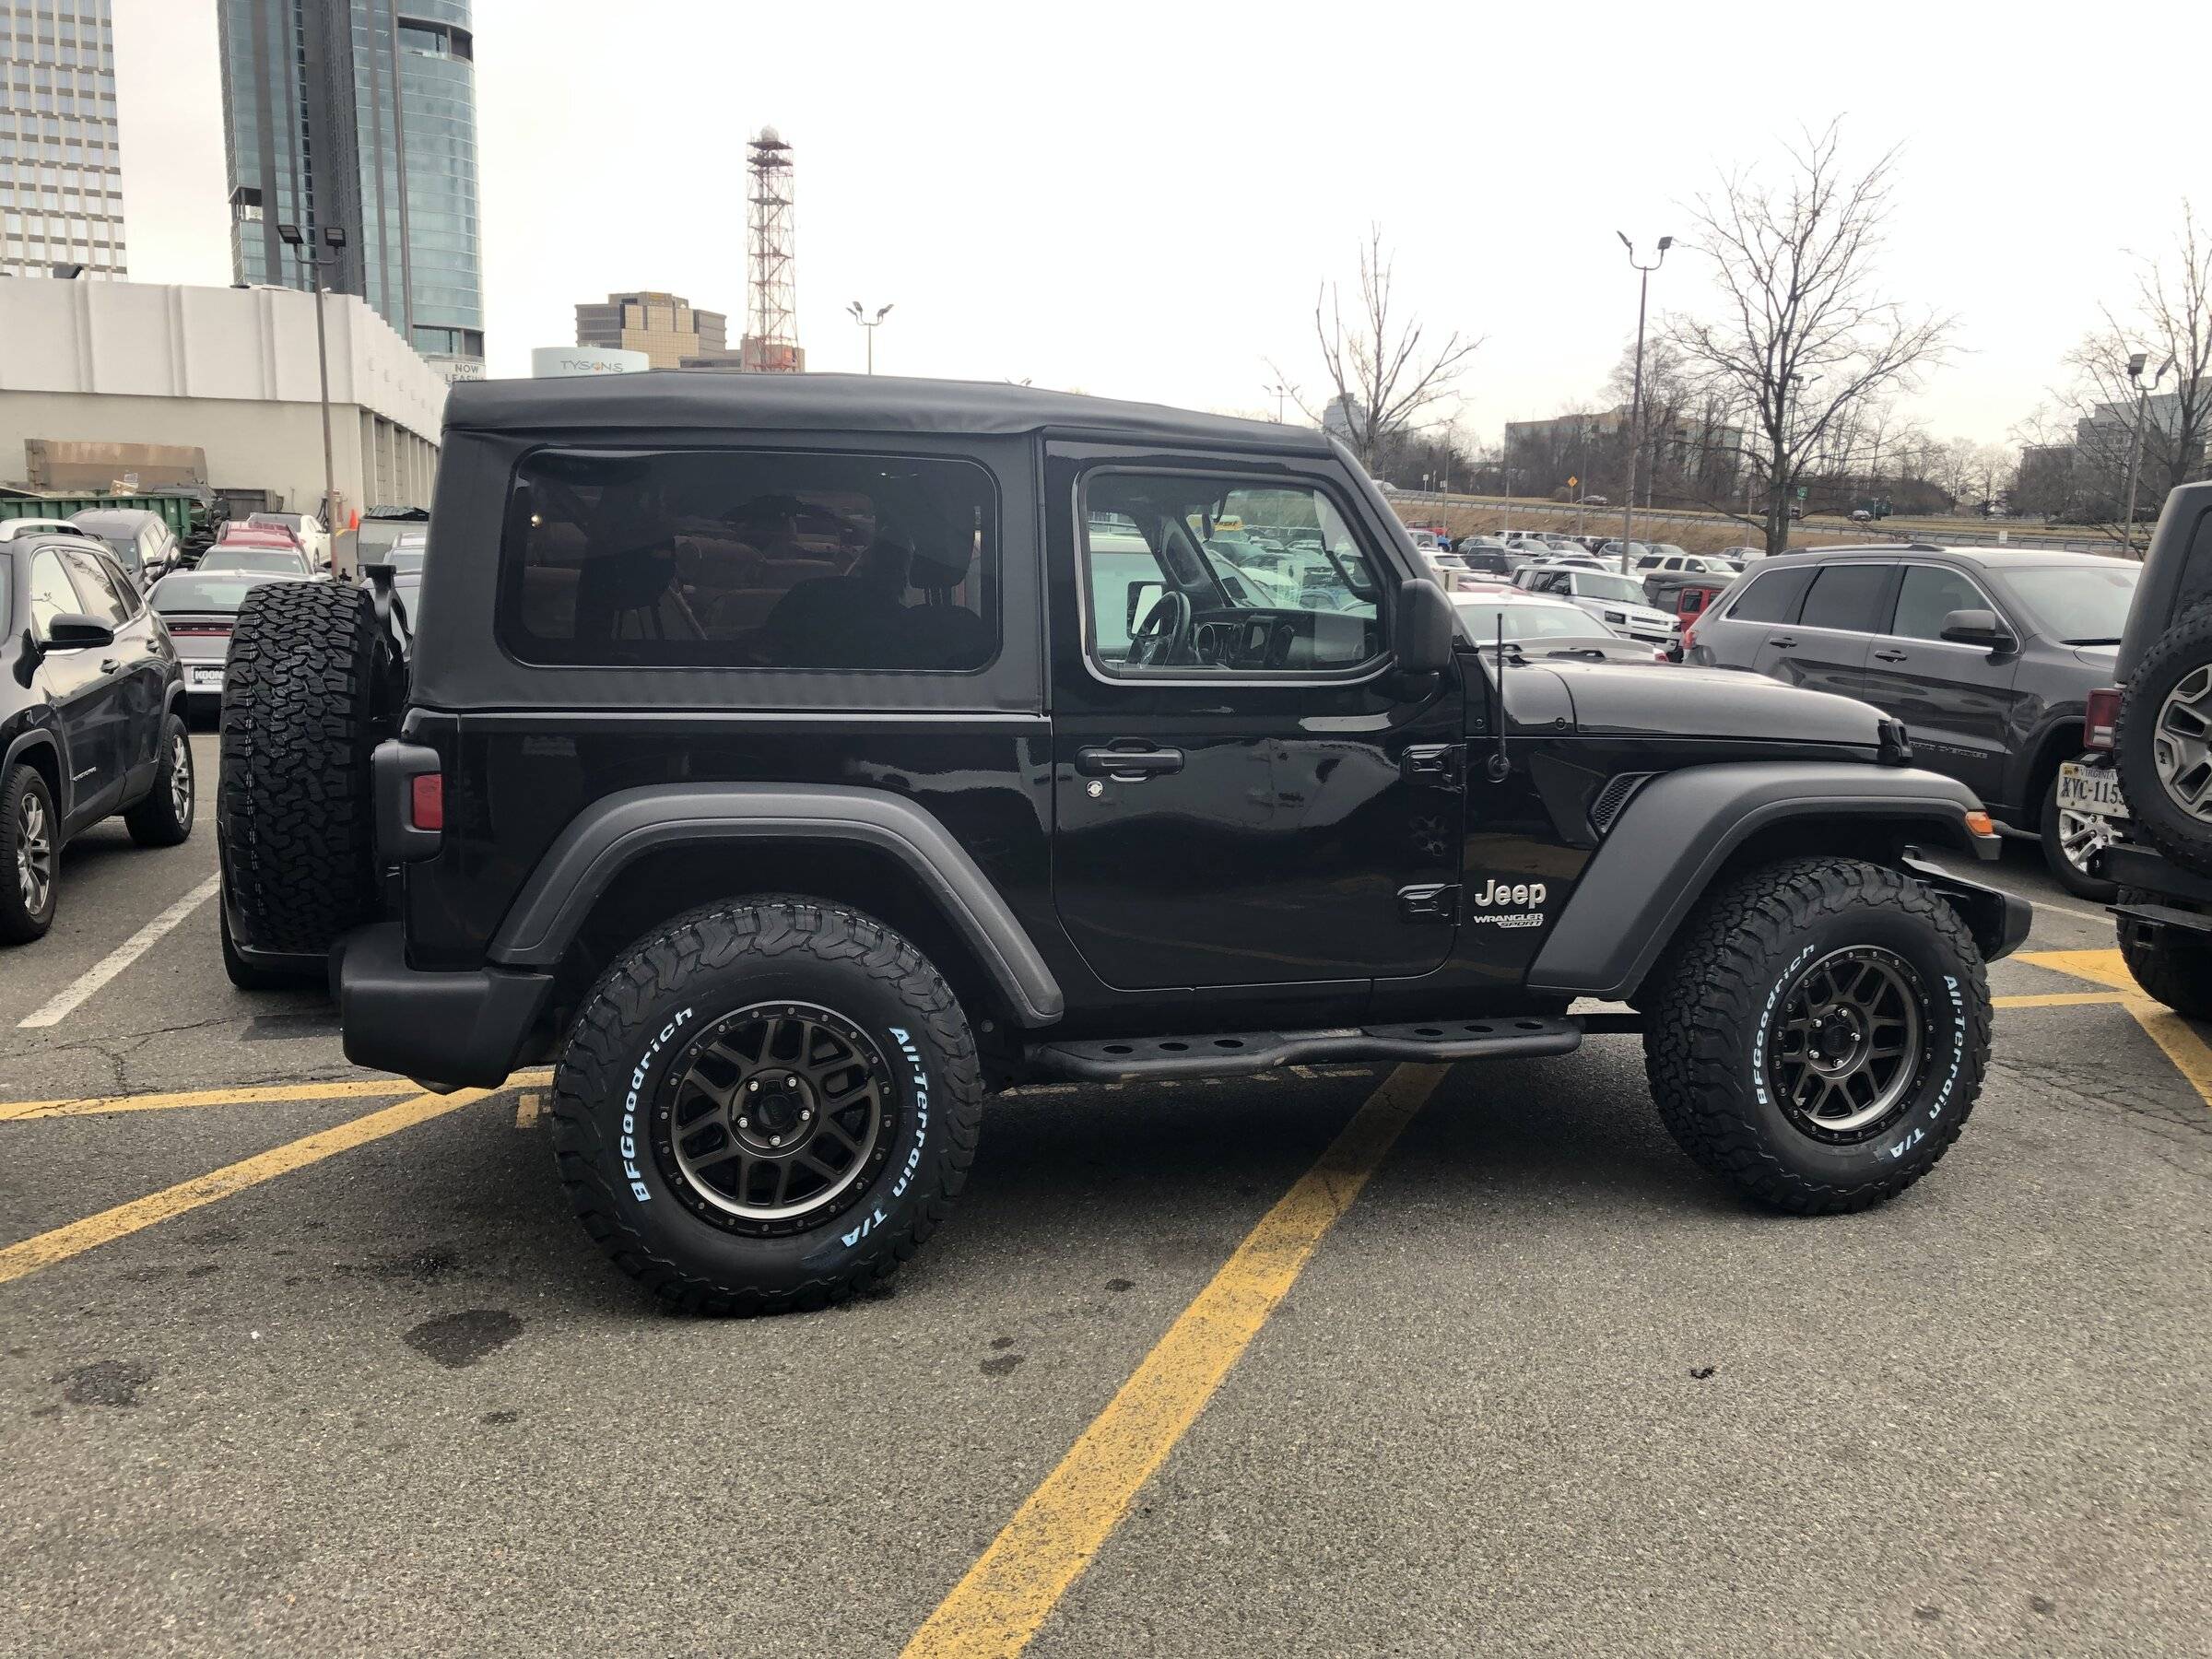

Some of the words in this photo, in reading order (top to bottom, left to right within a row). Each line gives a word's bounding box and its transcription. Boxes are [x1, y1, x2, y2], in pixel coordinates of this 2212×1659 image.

[454, 364, 479, 373] NOW
[559, 360, 624, 373] TYSONS
[194, 670, 225, 680] KOON
[1474, 879, 1547, 910] Jeep
[1473, 912, 1545, 924] WRANGLER
[1752, 944, 1816, 1104] BFGoodrich
[1928, 974, 1967, 1121] All-Terrain
[619, 1006, 694, 1202] BFGoodrich
[888, 1025, 929, 1198] All-Terrain
